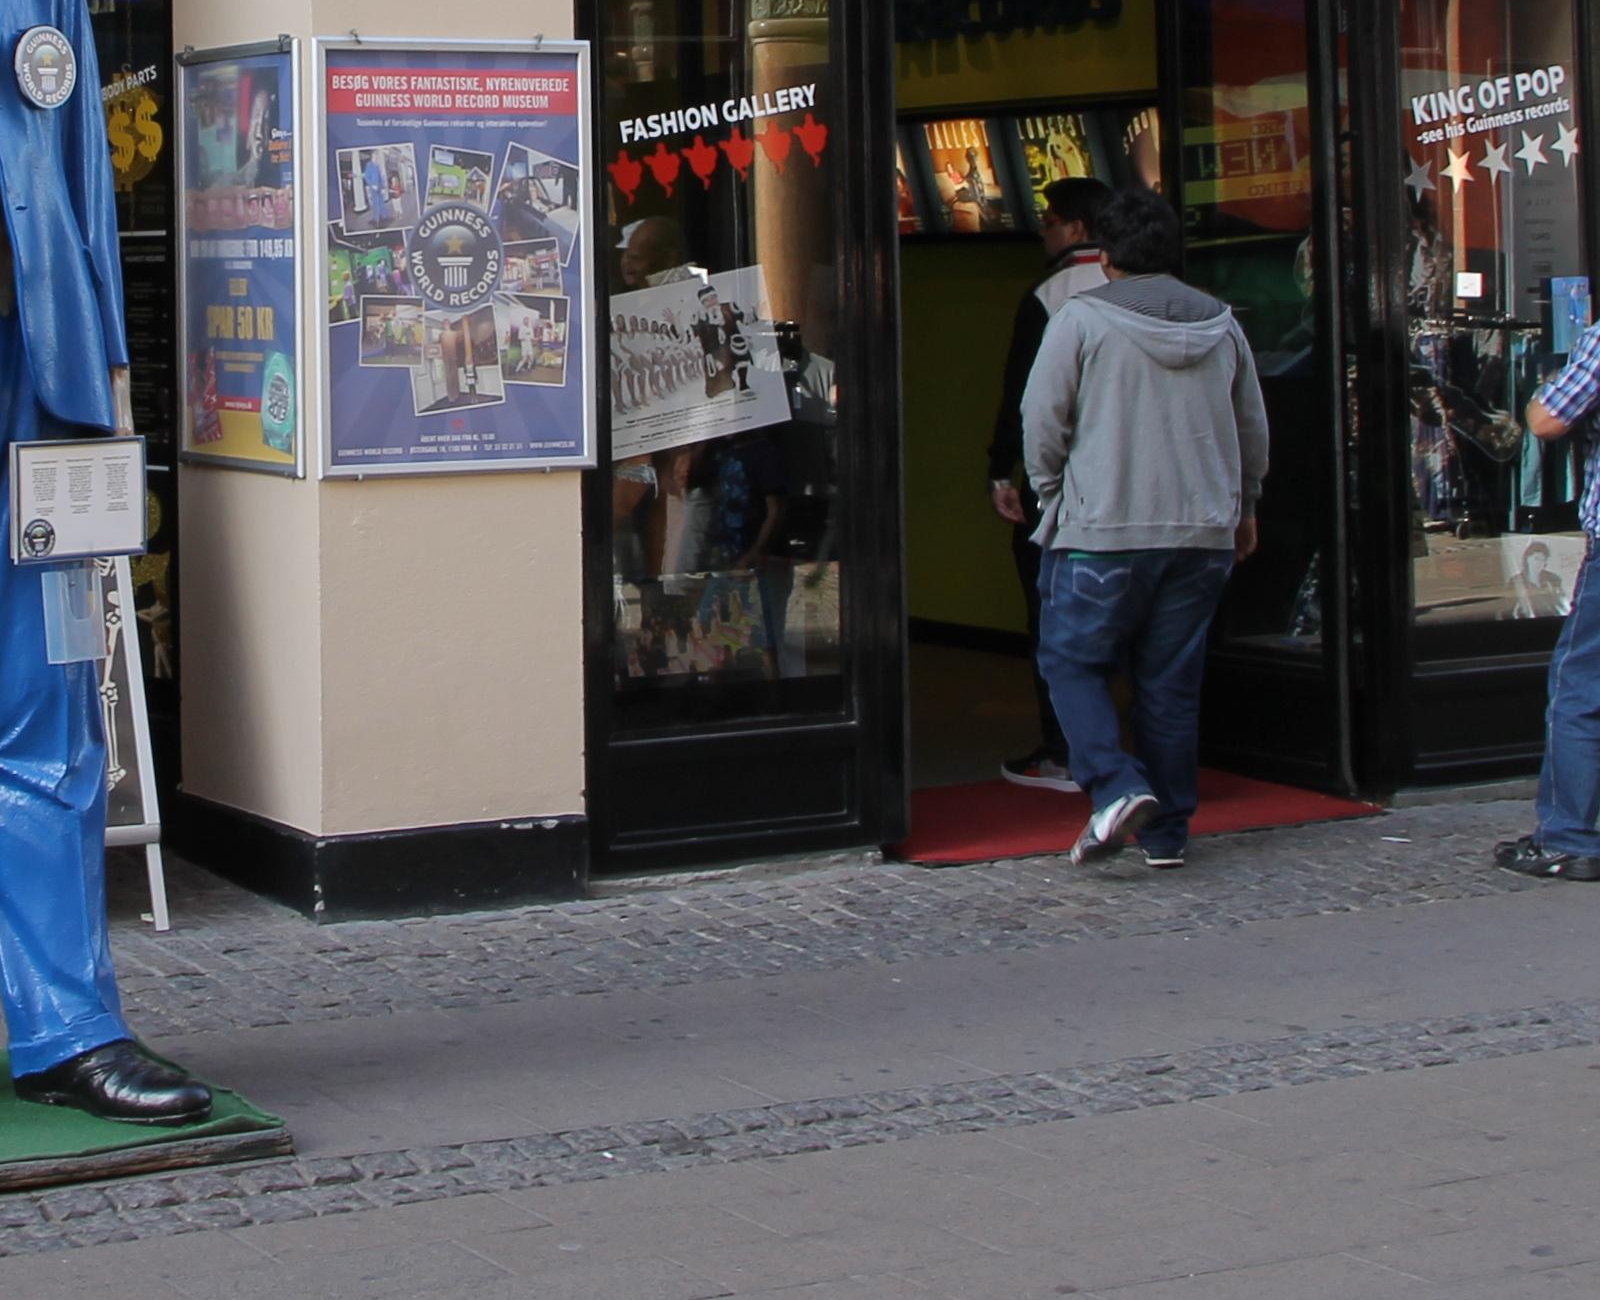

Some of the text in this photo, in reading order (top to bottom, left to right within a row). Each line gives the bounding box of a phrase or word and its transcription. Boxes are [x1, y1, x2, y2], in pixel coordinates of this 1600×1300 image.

[26, 32, 68, 55] GUINNESS
[23, 62, 73, 104] WORLD RECORDS
[126, 64, 157, 91] PARTS
[332, 74, 570, 92] BESØG VORES FANTASTISKE, NYRENOVEREDE
[355, 94, 549, 109] GUINNESS WORLD RECORD MUSEUM
[1411, 65, 1565, 125] KING OF POP
[619, 83, 816, 144] FASHION GALLERY
[1445, 121, 1466, 140] his
[1466, 111, 1524, 134] Guinness
[1525, 97, 1570, 120] records
[924, 120, 990, 150] TALLEST
[419, 209, 491, 238] GUINNESS
[411, 250, 499, 306] WORLD RECORDS
